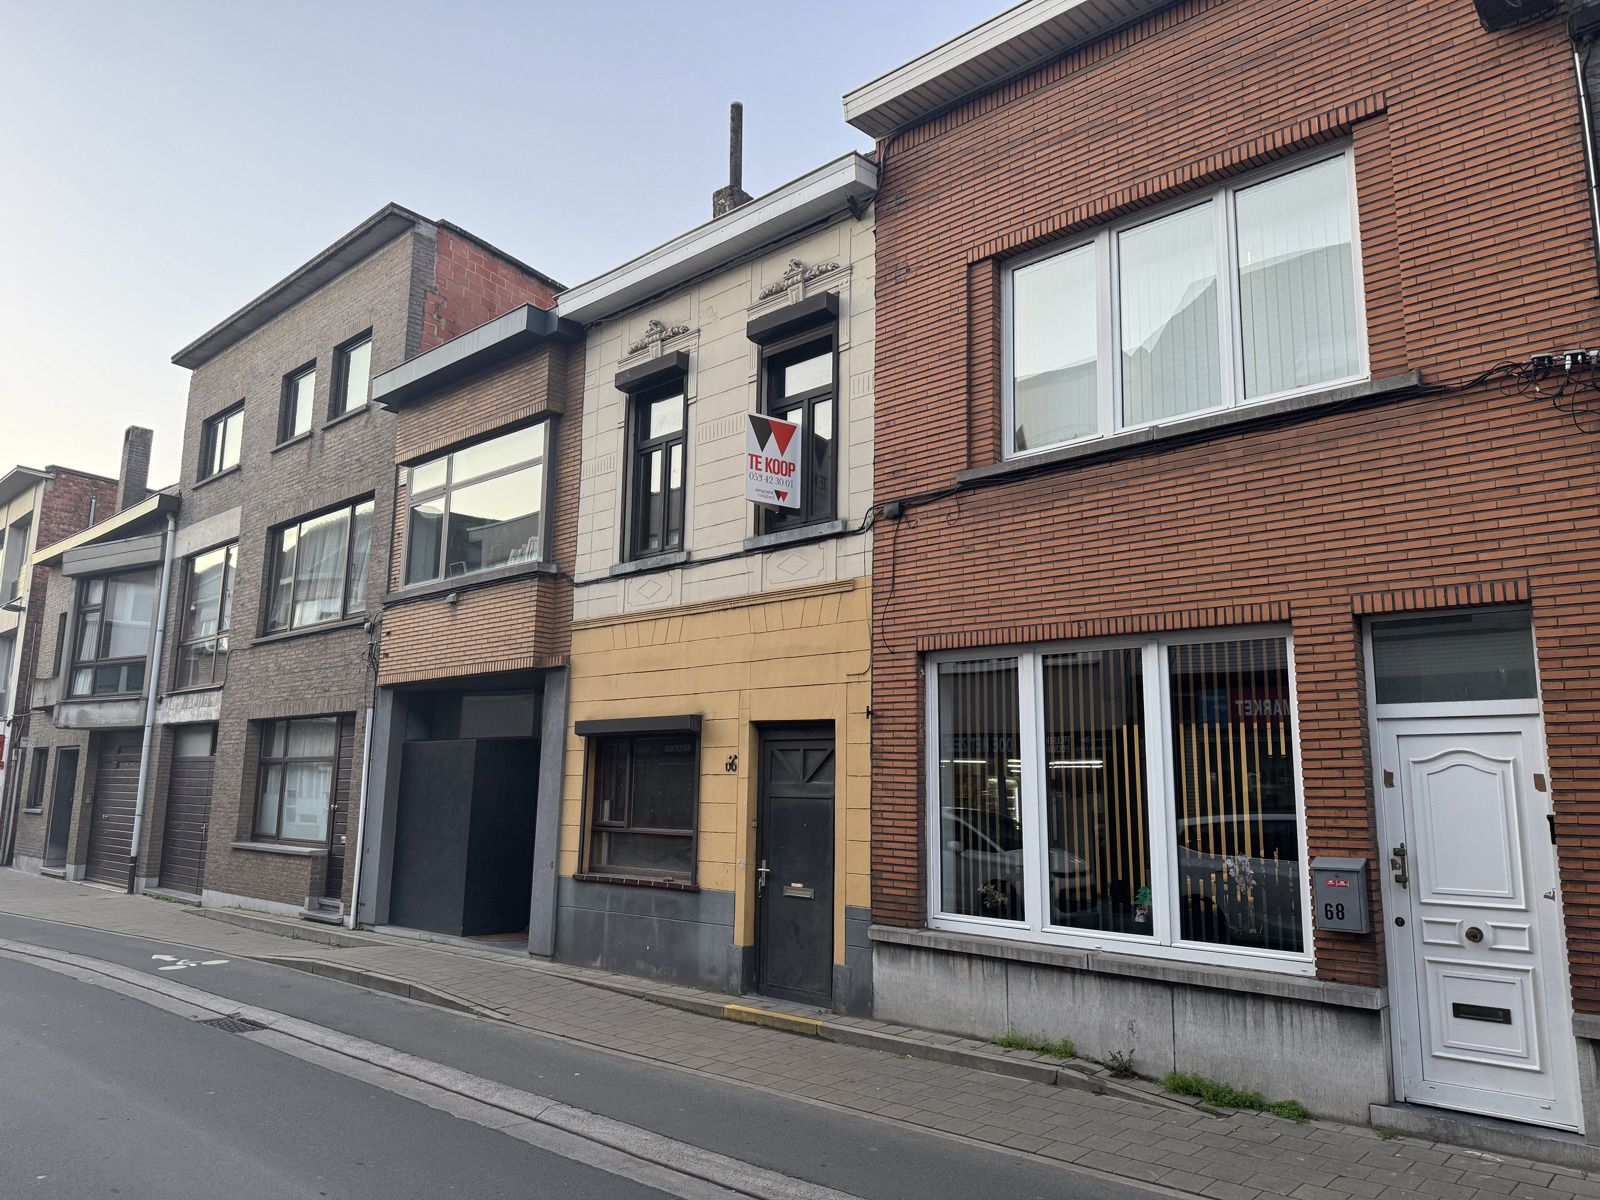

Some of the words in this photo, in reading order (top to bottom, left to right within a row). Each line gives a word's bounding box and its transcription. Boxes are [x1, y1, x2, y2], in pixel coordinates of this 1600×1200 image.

[748, 453, 762, 471] TE
[765, 457, 796, 477] KOOP
[749, 471, 763, 482] 053
[765, 475, 774, 485] 42
[774, 476, 784, 486] 30
[785, 480, 794, 489] 01
[1324, 902, 1345, 921] 68
